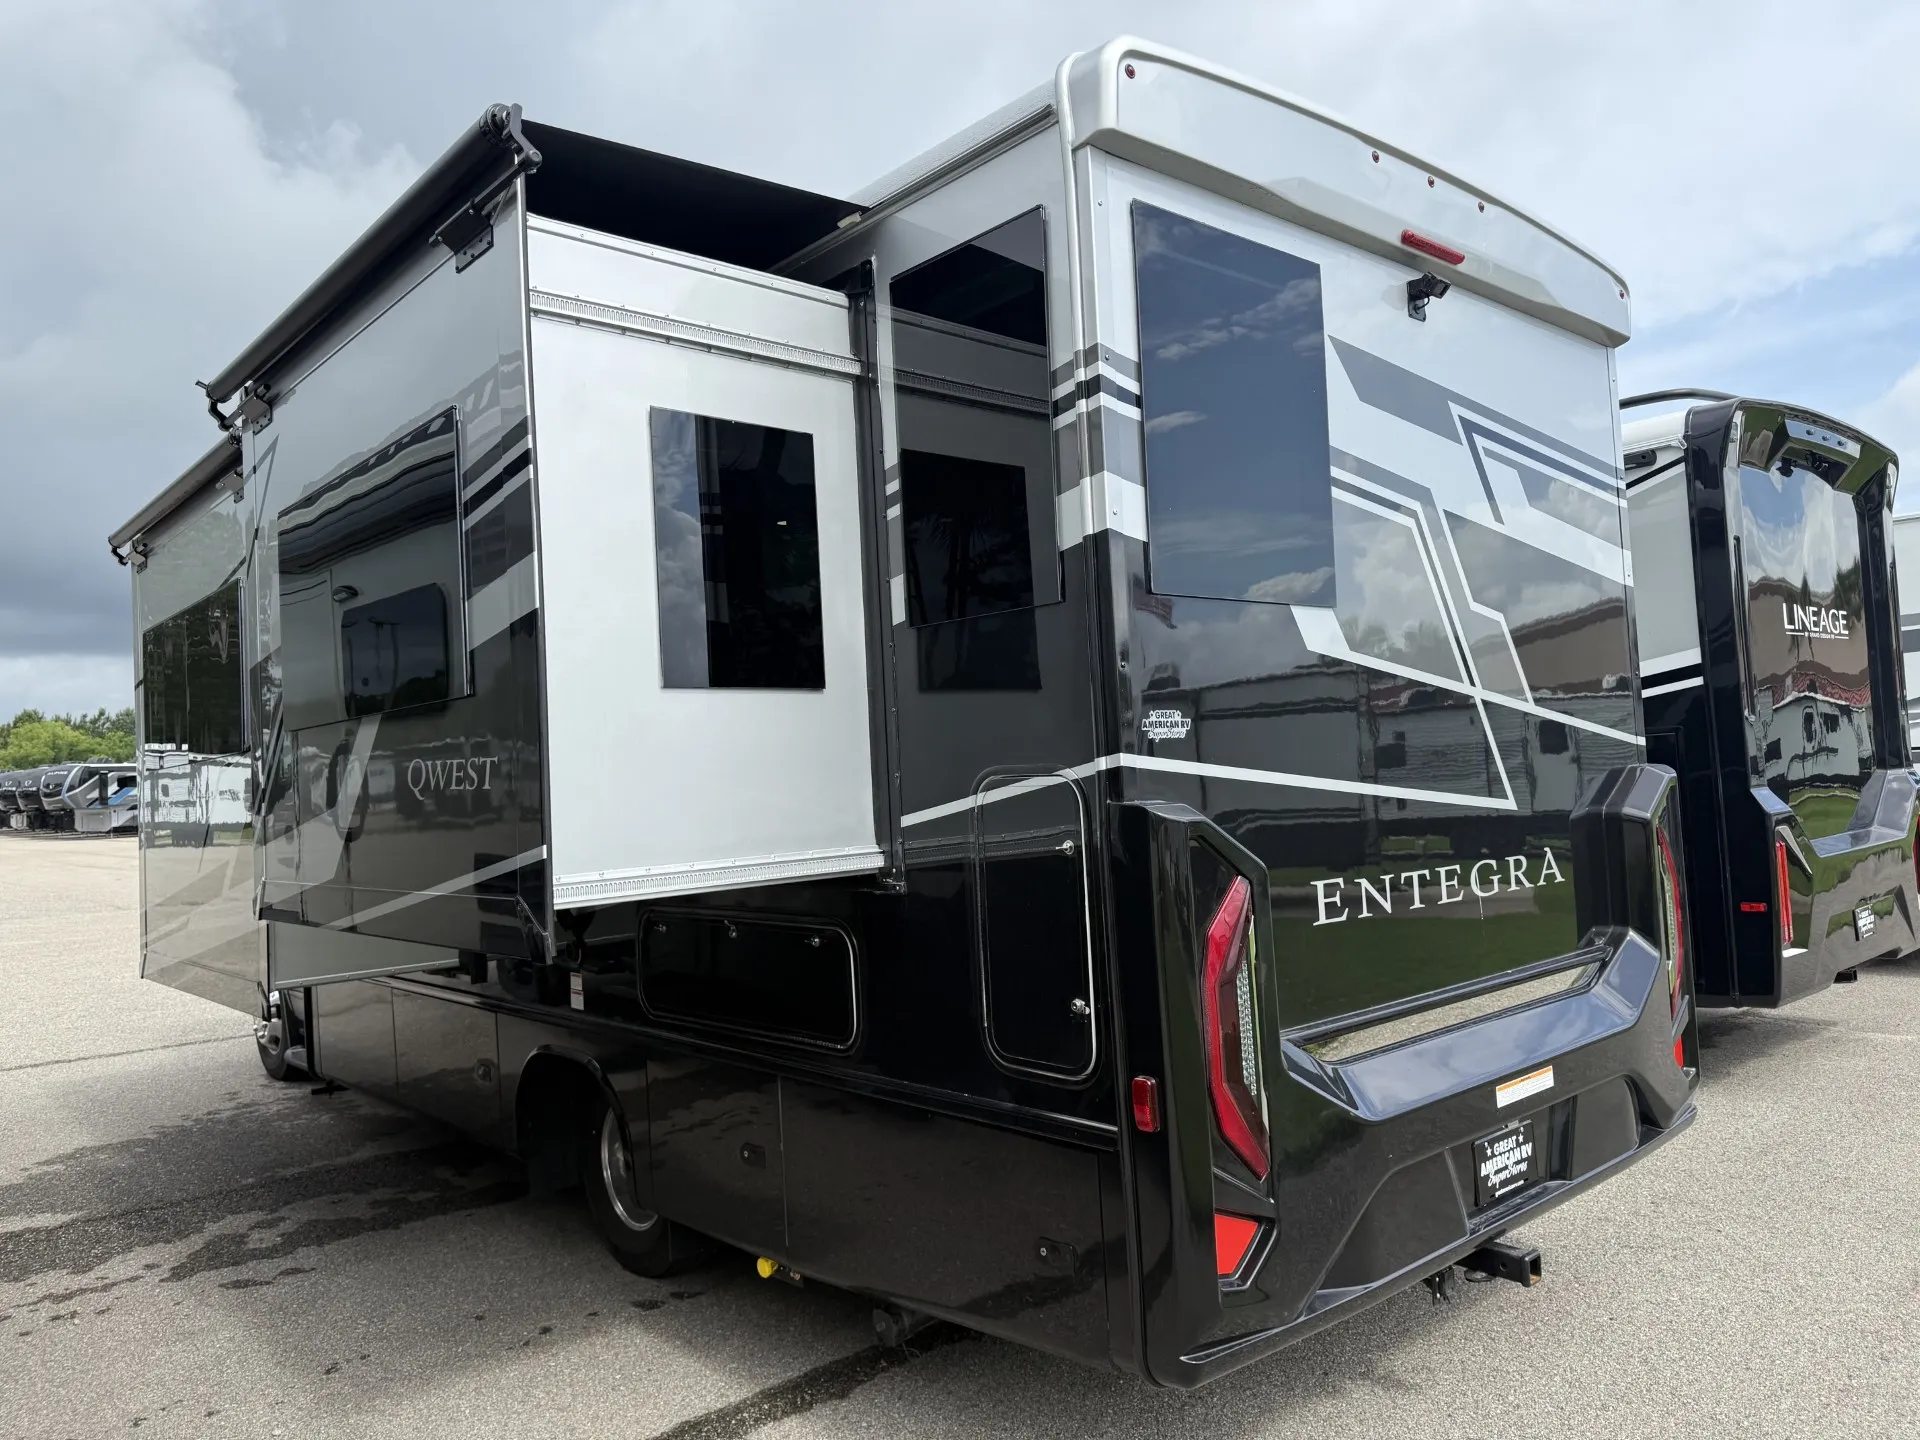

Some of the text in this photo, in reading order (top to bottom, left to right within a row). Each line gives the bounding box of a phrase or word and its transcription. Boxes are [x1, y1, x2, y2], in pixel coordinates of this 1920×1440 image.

[1782, 602, 1849, 634] LINEAGE
[1143, 720, 1190, 729] AMERICAN RV
[1155, 711, 1175, 719] GREAT
[407, 755, 498, 800] QWEST
[1310, 847, 1565, 925] ENTEGRA
[1481, 1142, 1533, 1177] AMERICAN RV
[1494, 1136, 1517, 1154] GREAT
